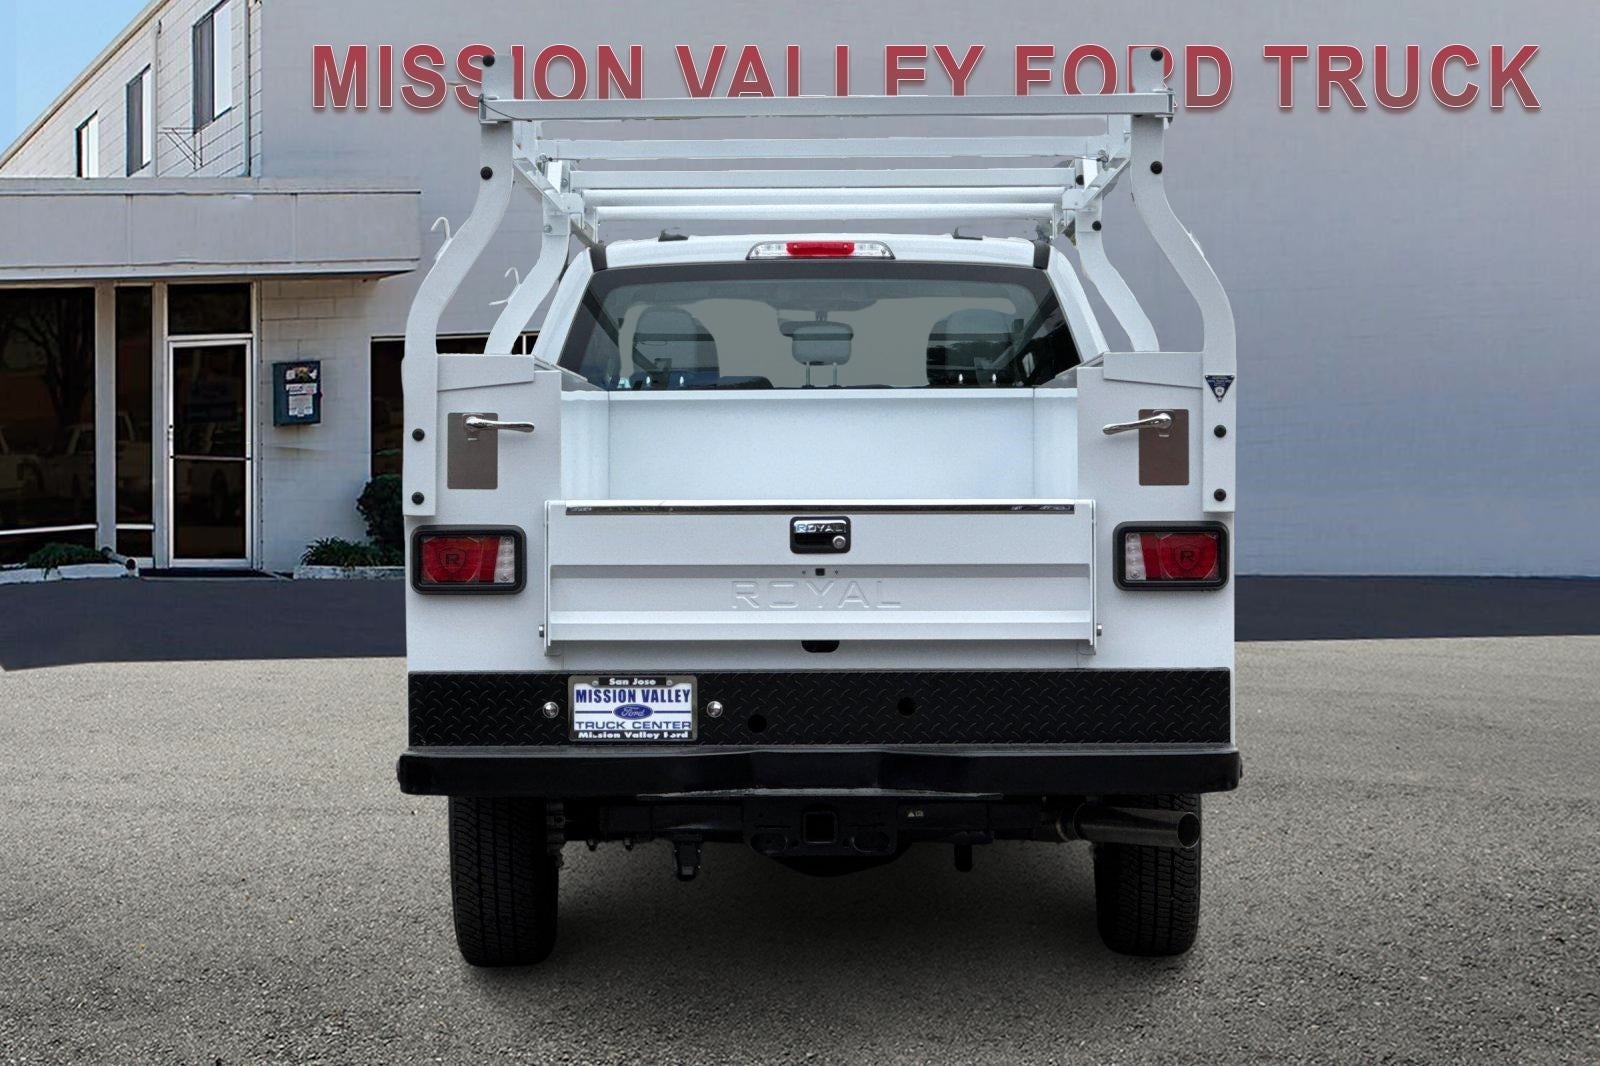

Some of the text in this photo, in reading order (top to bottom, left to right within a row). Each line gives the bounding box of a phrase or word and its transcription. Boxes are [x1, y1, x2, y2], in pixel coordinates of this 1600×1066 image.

[312, 44, 644, 110] MISSION
[675, 45, 985, 98] VALLEY
[1263, 44, 1541, 109] TRUCK
[731, 580, 901, 609] ROYAL
[609, 678, 657, 686] San Jose
[575, 689, 691, 703] MISSION VALLEY
[620, 708, 645, 718] Ford
[576, 721, 692, 729] TRUCK CENTER
[625, 731, 660, 740] Valley
